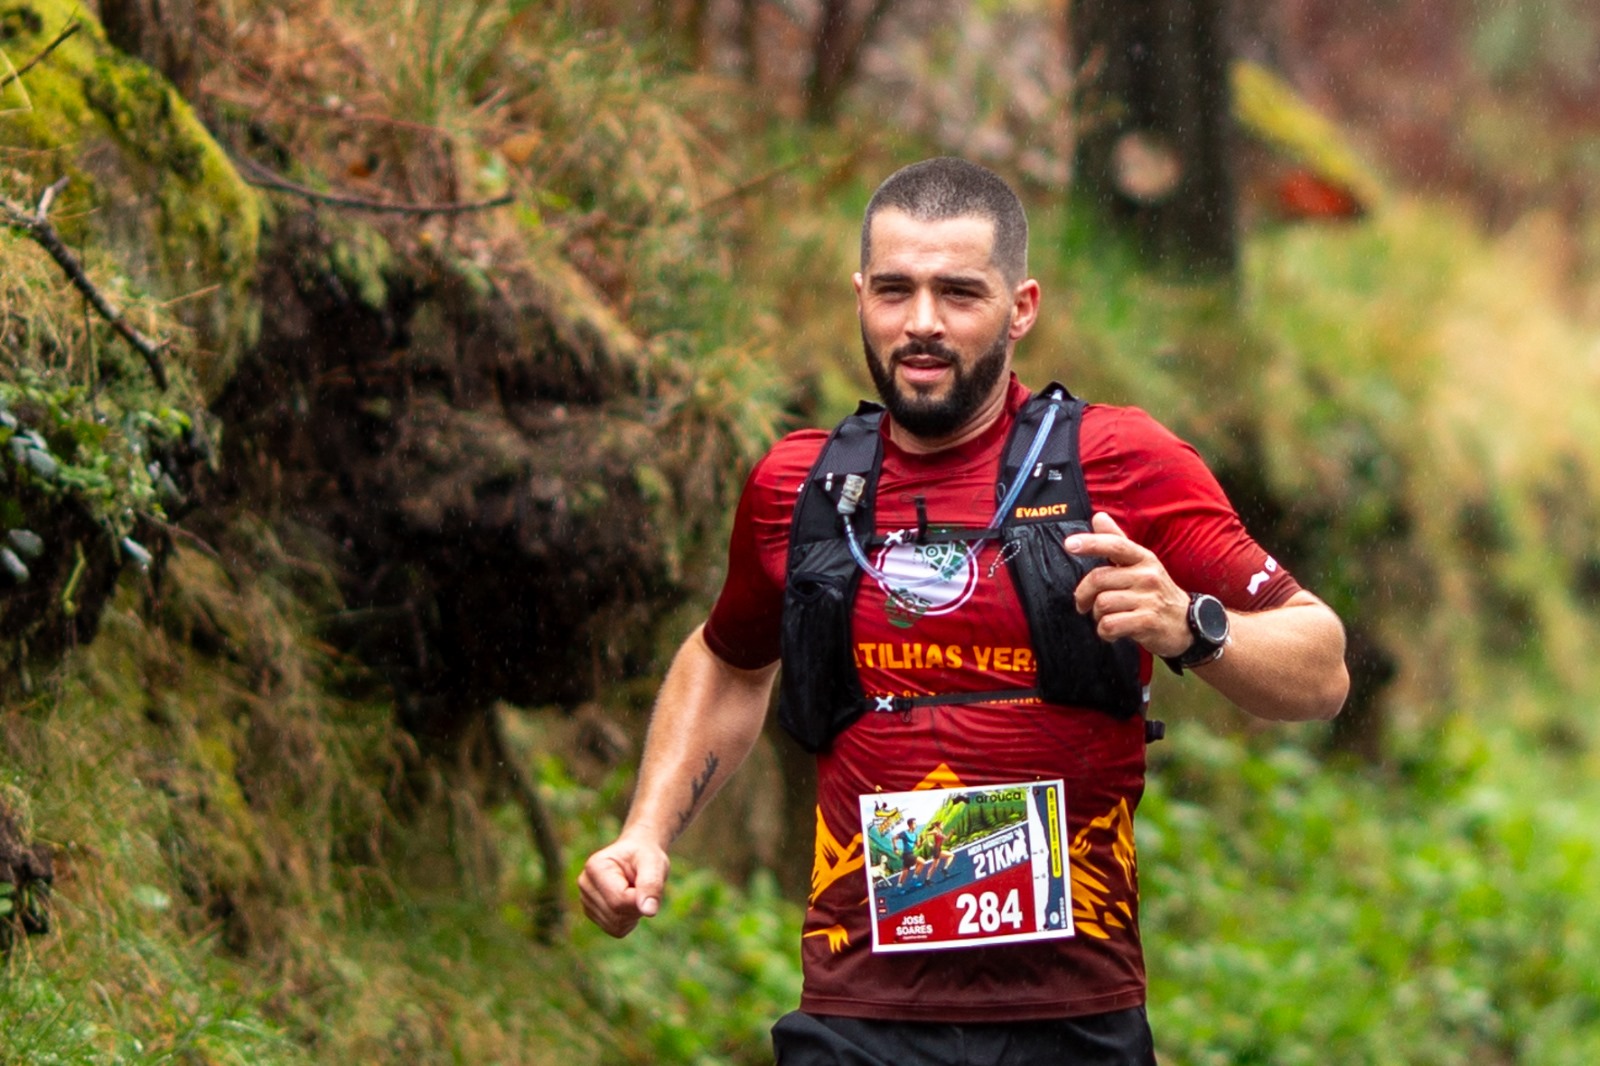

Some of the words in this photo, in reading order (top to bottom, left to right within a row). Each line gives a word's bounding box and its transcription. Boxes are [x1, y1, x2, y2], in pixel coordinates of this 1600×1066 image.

[1015, 504, 1067, 518] EVADICT
[973, 646, 1037, 672] VER
[975, 792, 1021, 804] arouca
[956, 888, 1023, 934] 284
[901, 913, 925, 926] JOSÉ
[896, 924, 933, 936] SOARES
